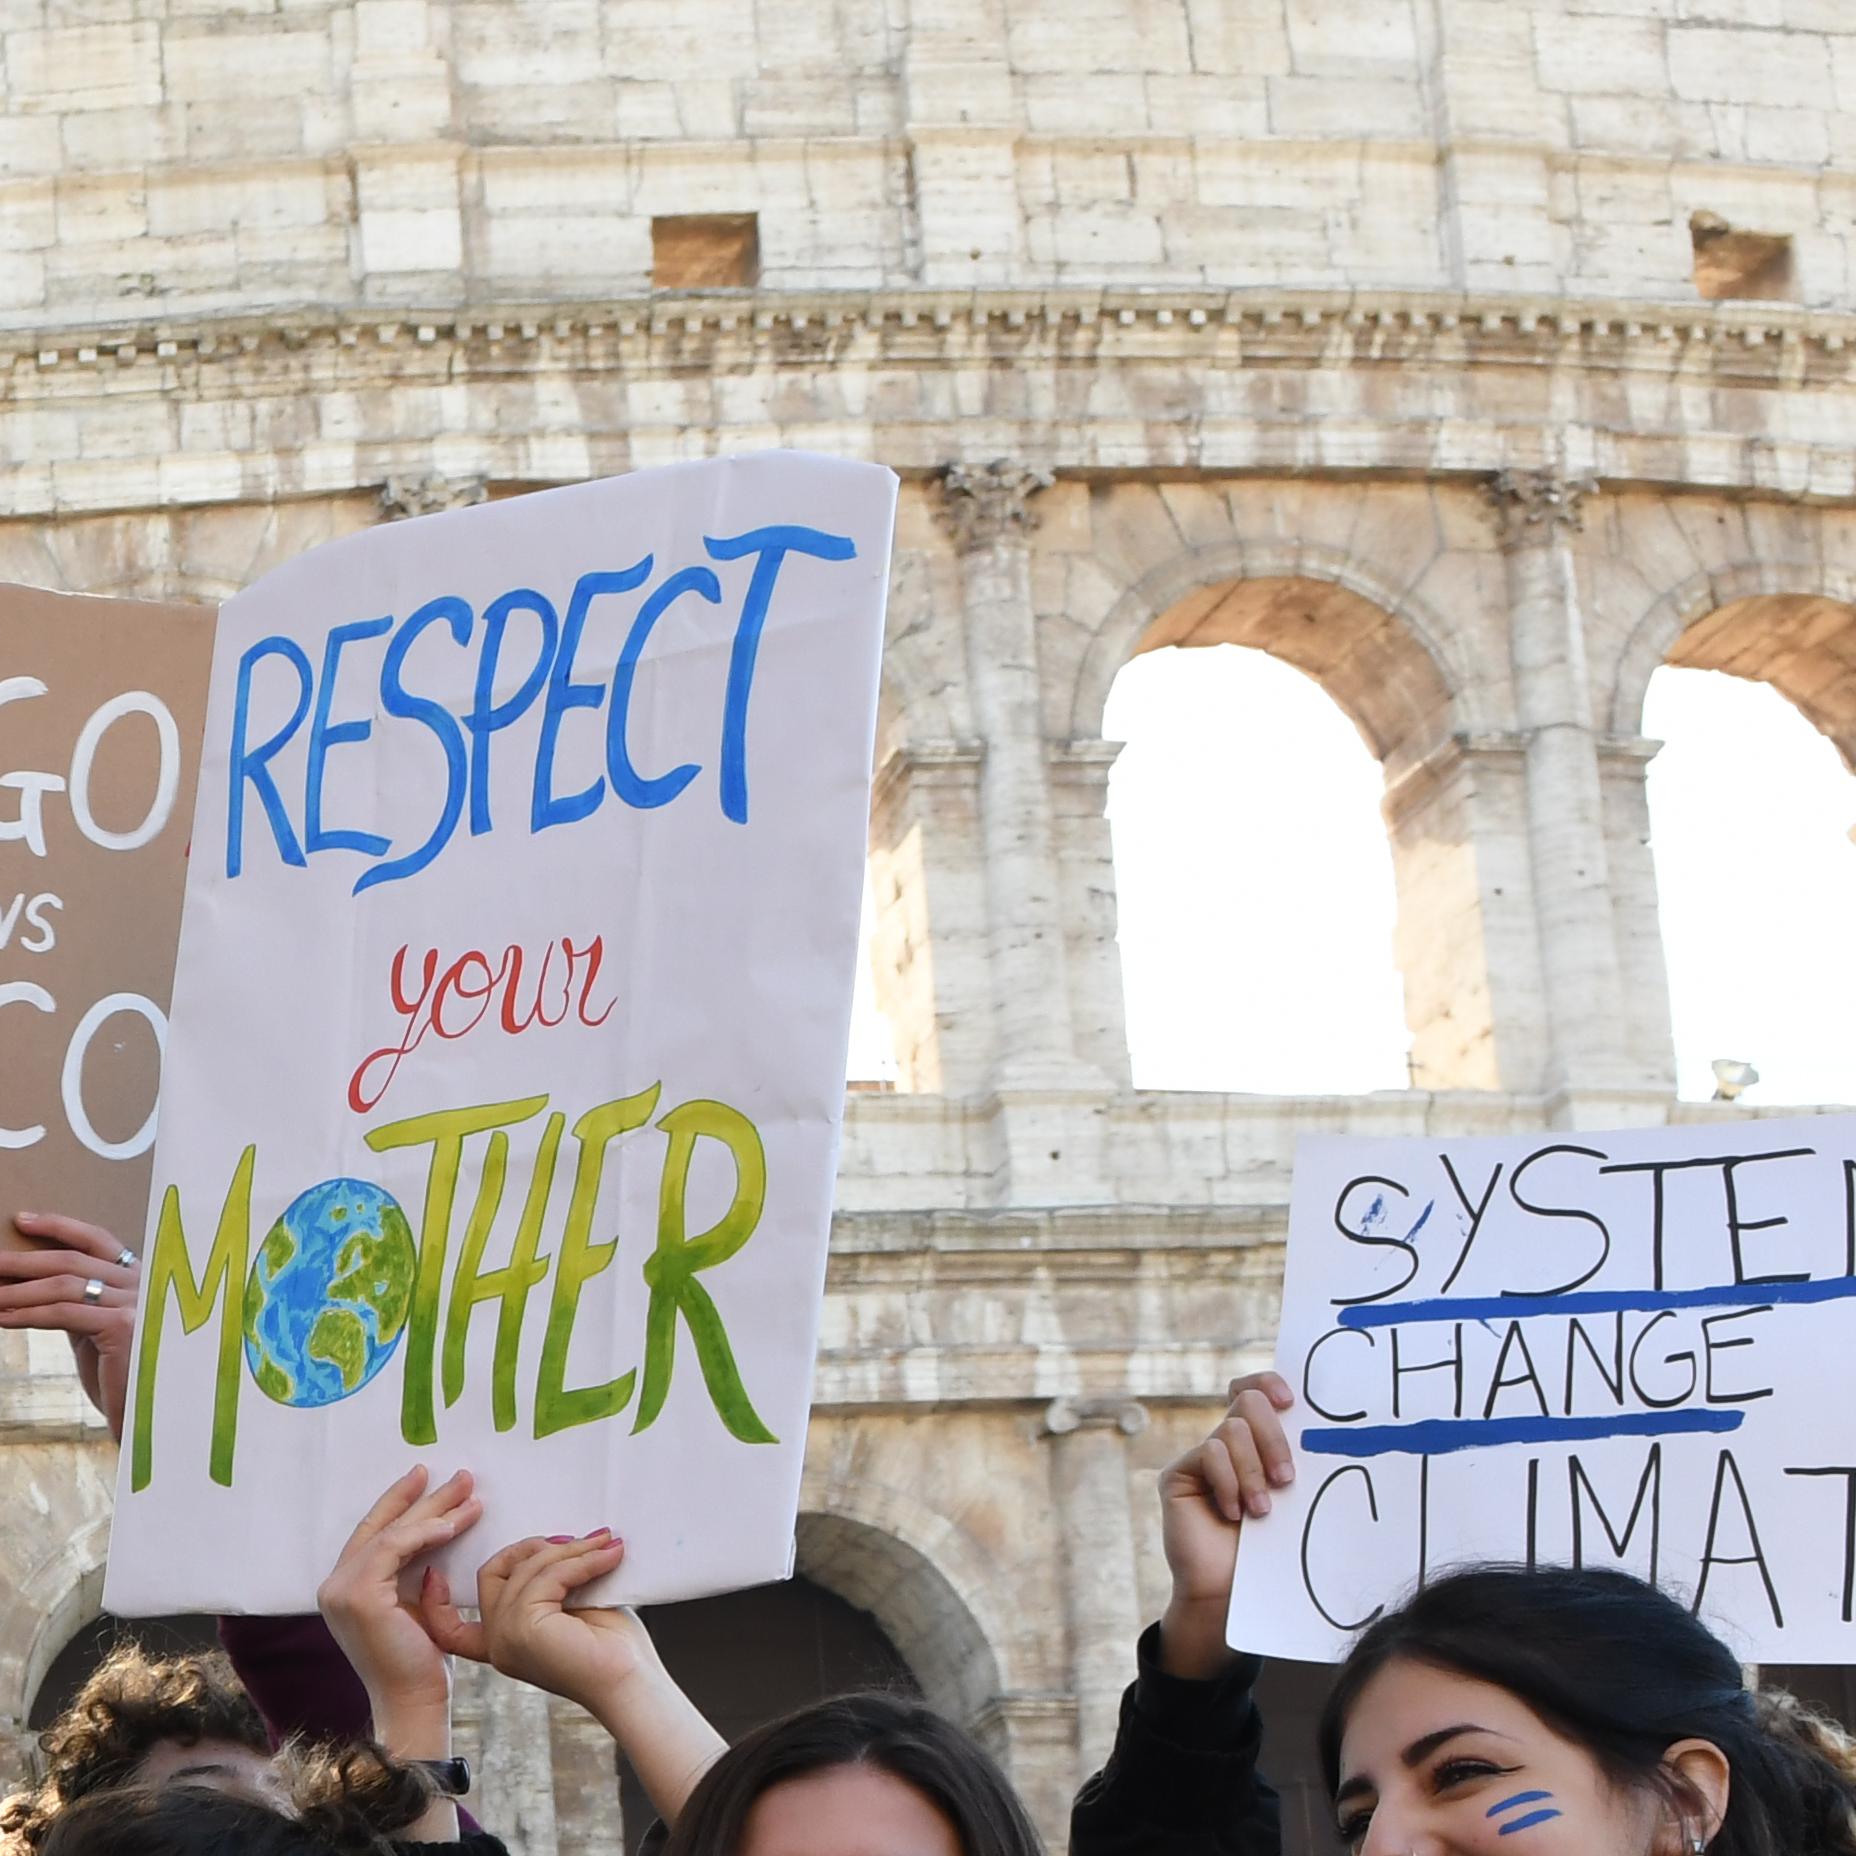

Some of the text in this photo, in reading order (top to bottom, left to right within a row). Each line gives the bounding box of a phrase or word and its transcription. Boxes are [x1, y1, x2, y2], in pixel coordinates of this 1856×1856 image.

[226, 524, 857, 896] RESPECT
[347, 931, 618, 1114] your
[1302, 1305, 1774, 1422] CHANGE
